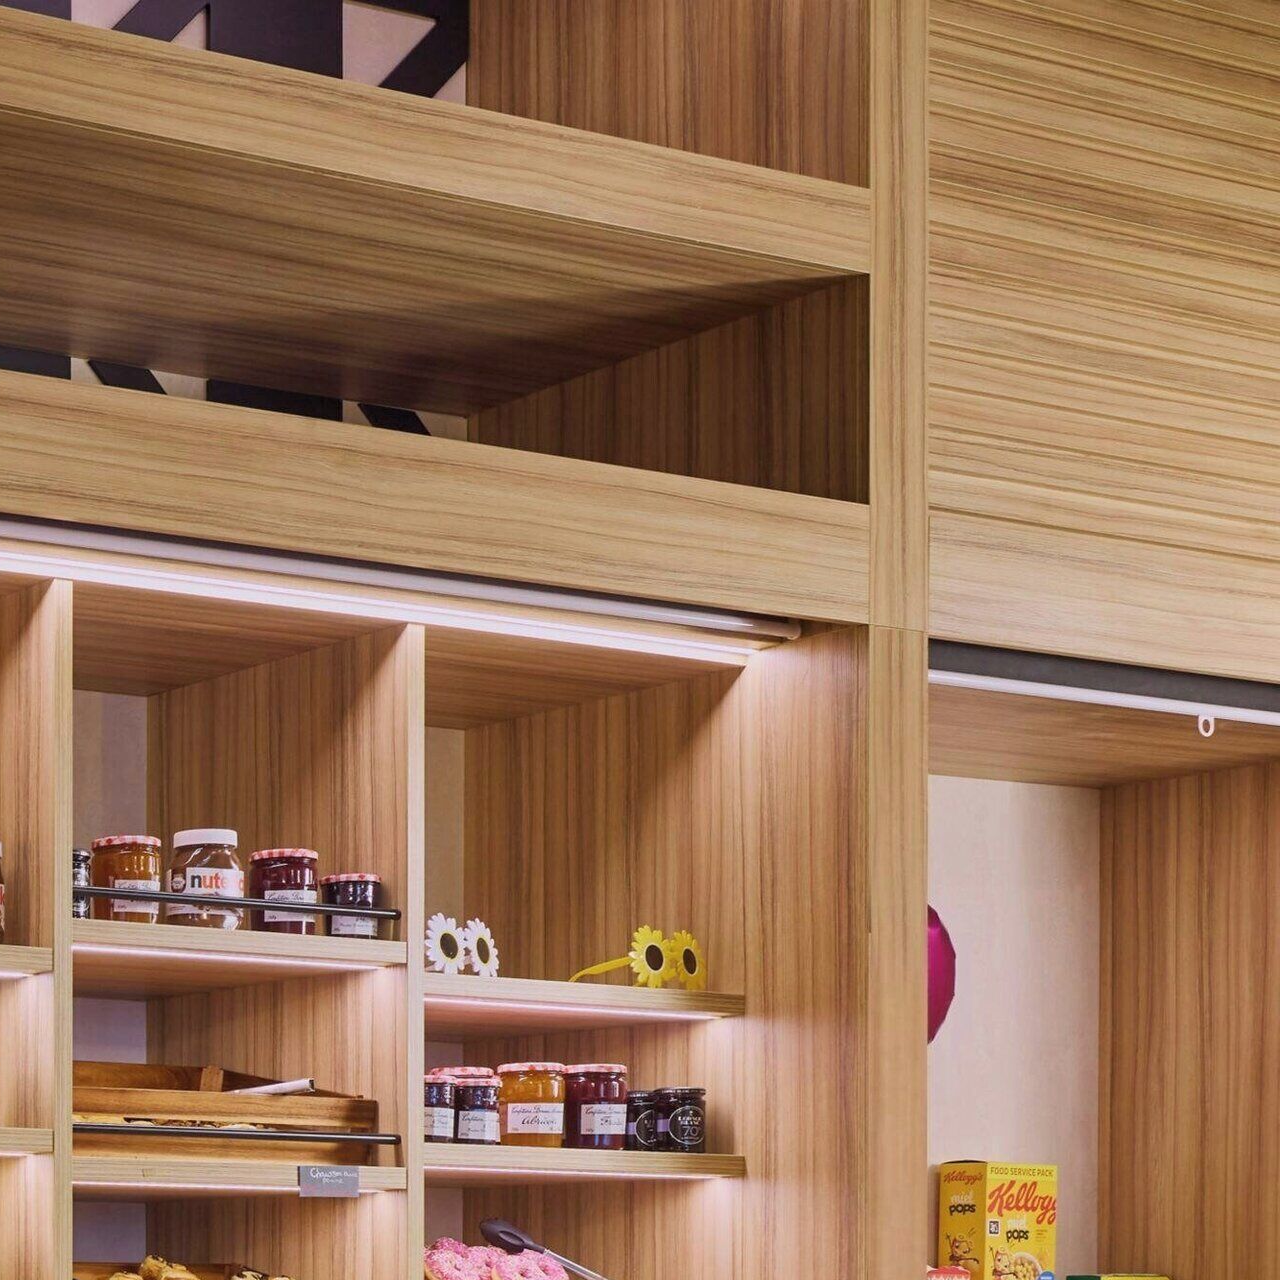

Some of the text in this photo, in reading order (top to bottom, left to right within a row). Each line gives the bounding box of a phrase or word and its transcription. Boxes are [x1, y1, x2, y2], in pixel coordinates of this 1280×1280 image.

[990, 1166, 1054, 1177] FOOD SERVICE PACK
[949, 1203, 976, 1216] pops
[1006, 1229, 1029, 1243] pops
